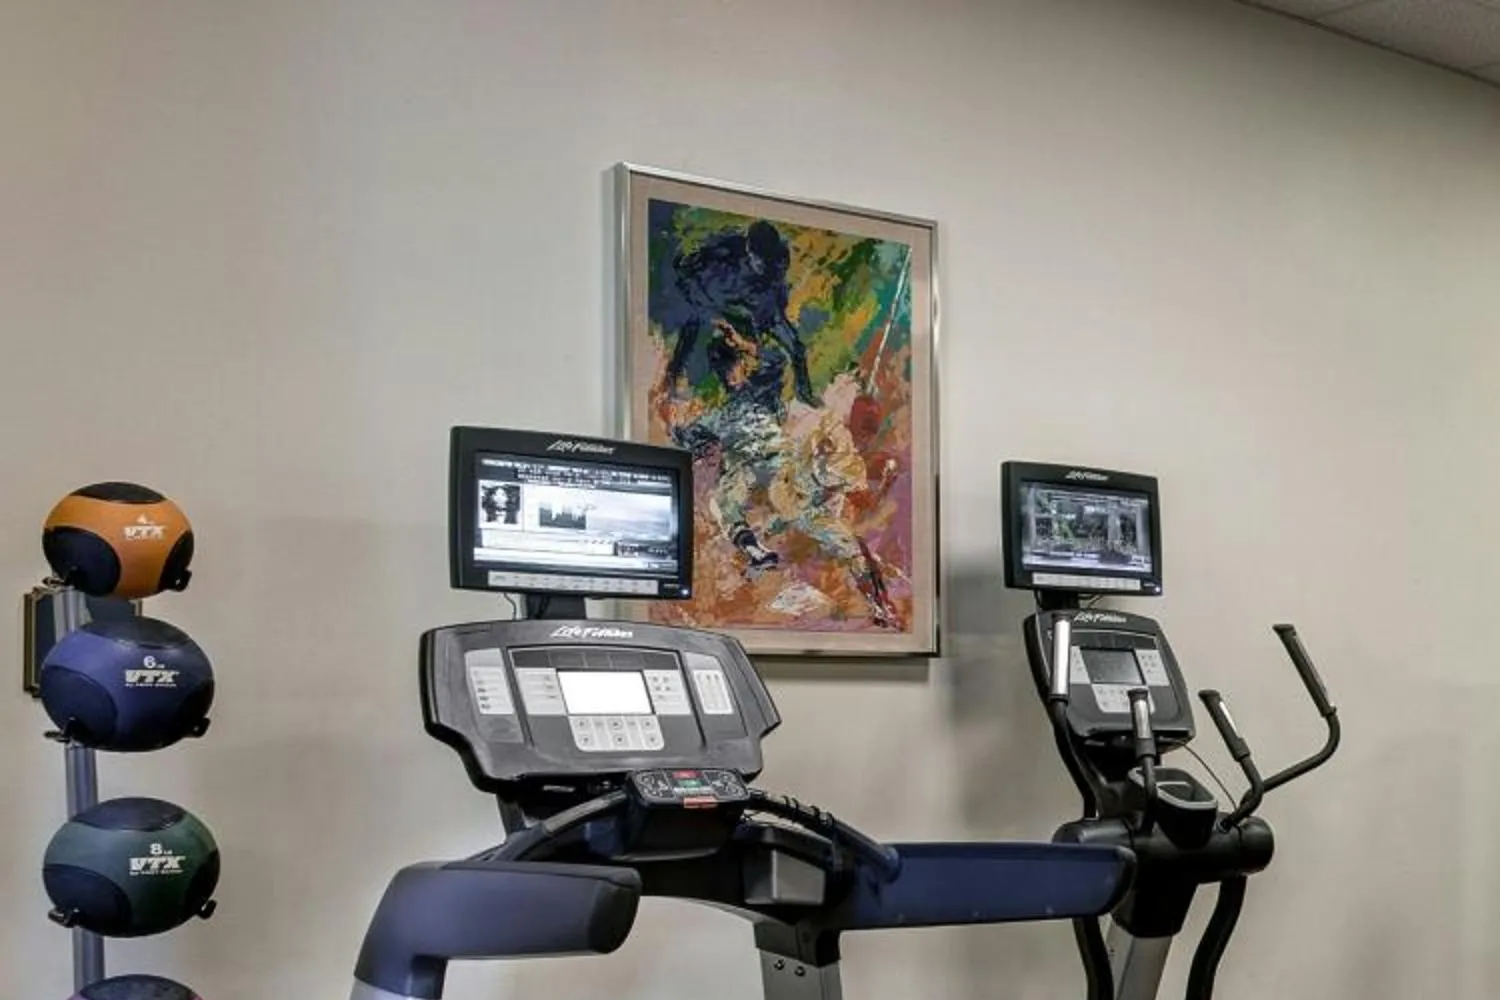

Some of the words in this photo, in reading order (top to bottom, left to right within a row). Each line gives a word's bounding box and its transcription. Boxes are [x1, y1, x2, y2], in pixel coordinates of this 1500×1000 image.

[143, 655, 157, 669] 6
[125, 669, 180, 683] VTX
[149, 842, 163, 855] 8
[130, 855, 186, 870] VTX
